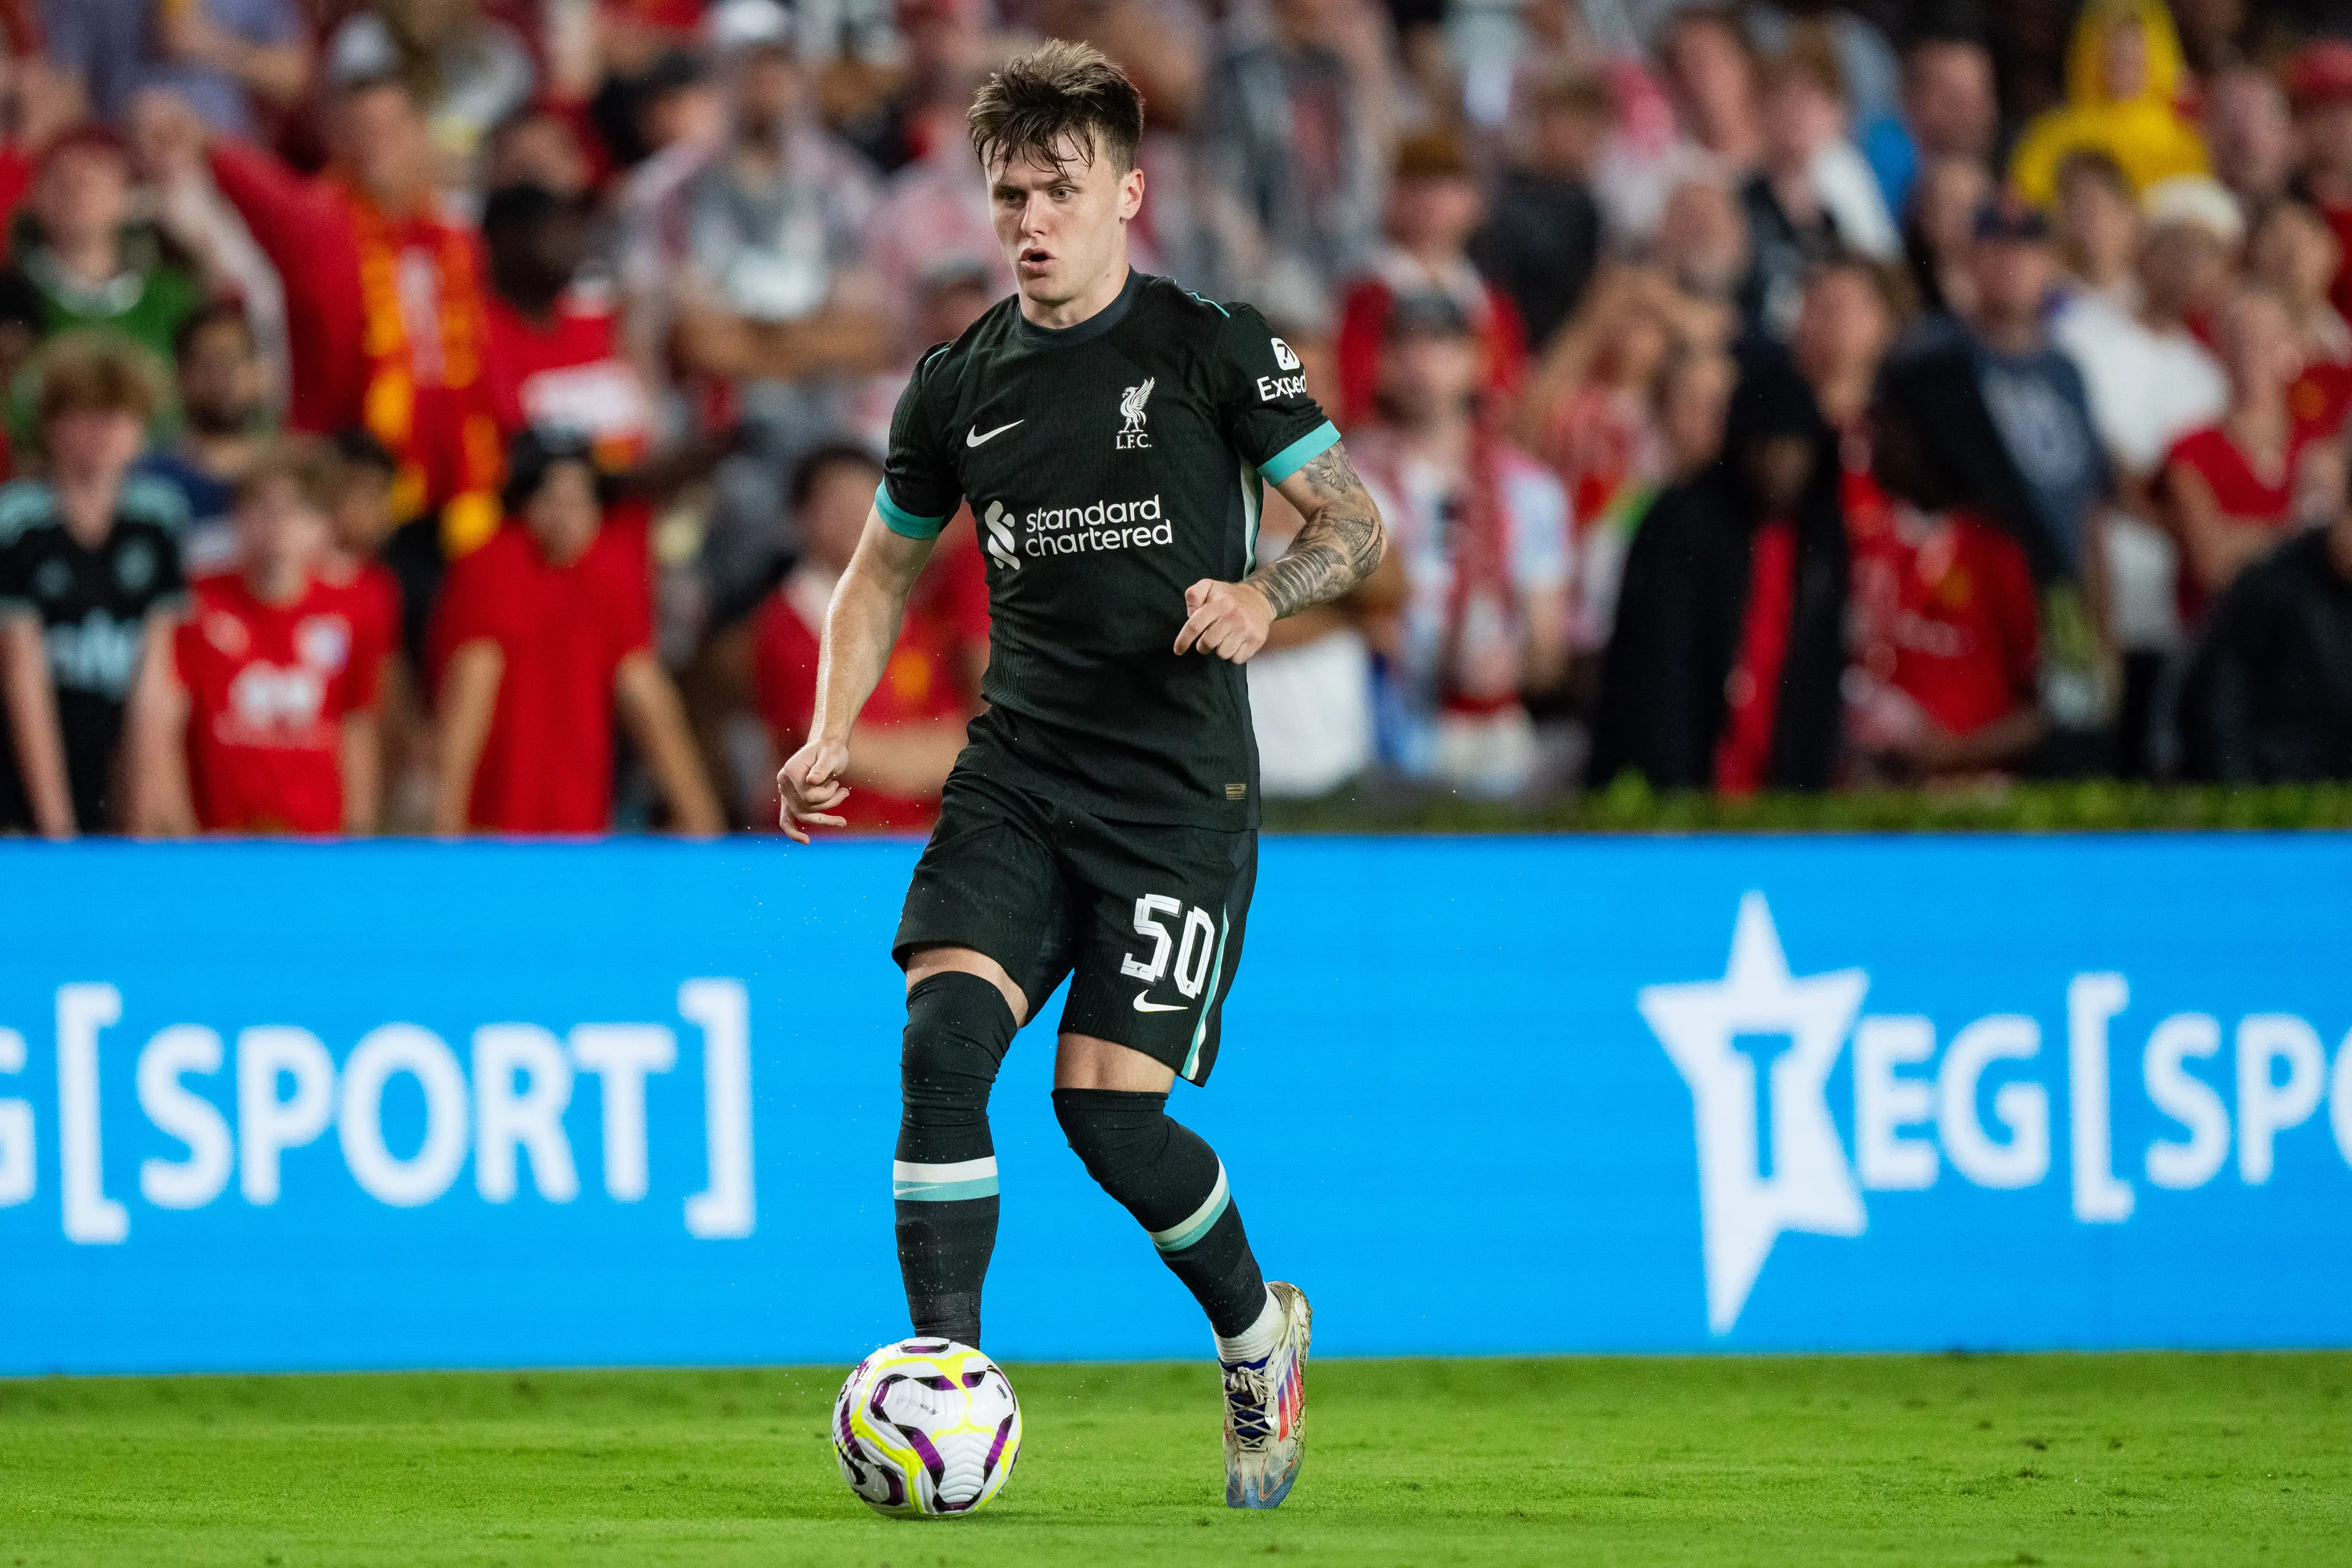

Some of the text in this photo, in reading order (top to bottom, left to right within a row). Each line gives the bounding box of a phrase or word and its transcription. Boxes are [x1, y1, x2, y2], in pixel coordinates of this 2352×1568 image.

[1026, 494, 1161, 533] standard
[1025, 519, 1173, 557] chartered
[1120, 893, 1215, 1000] 50
